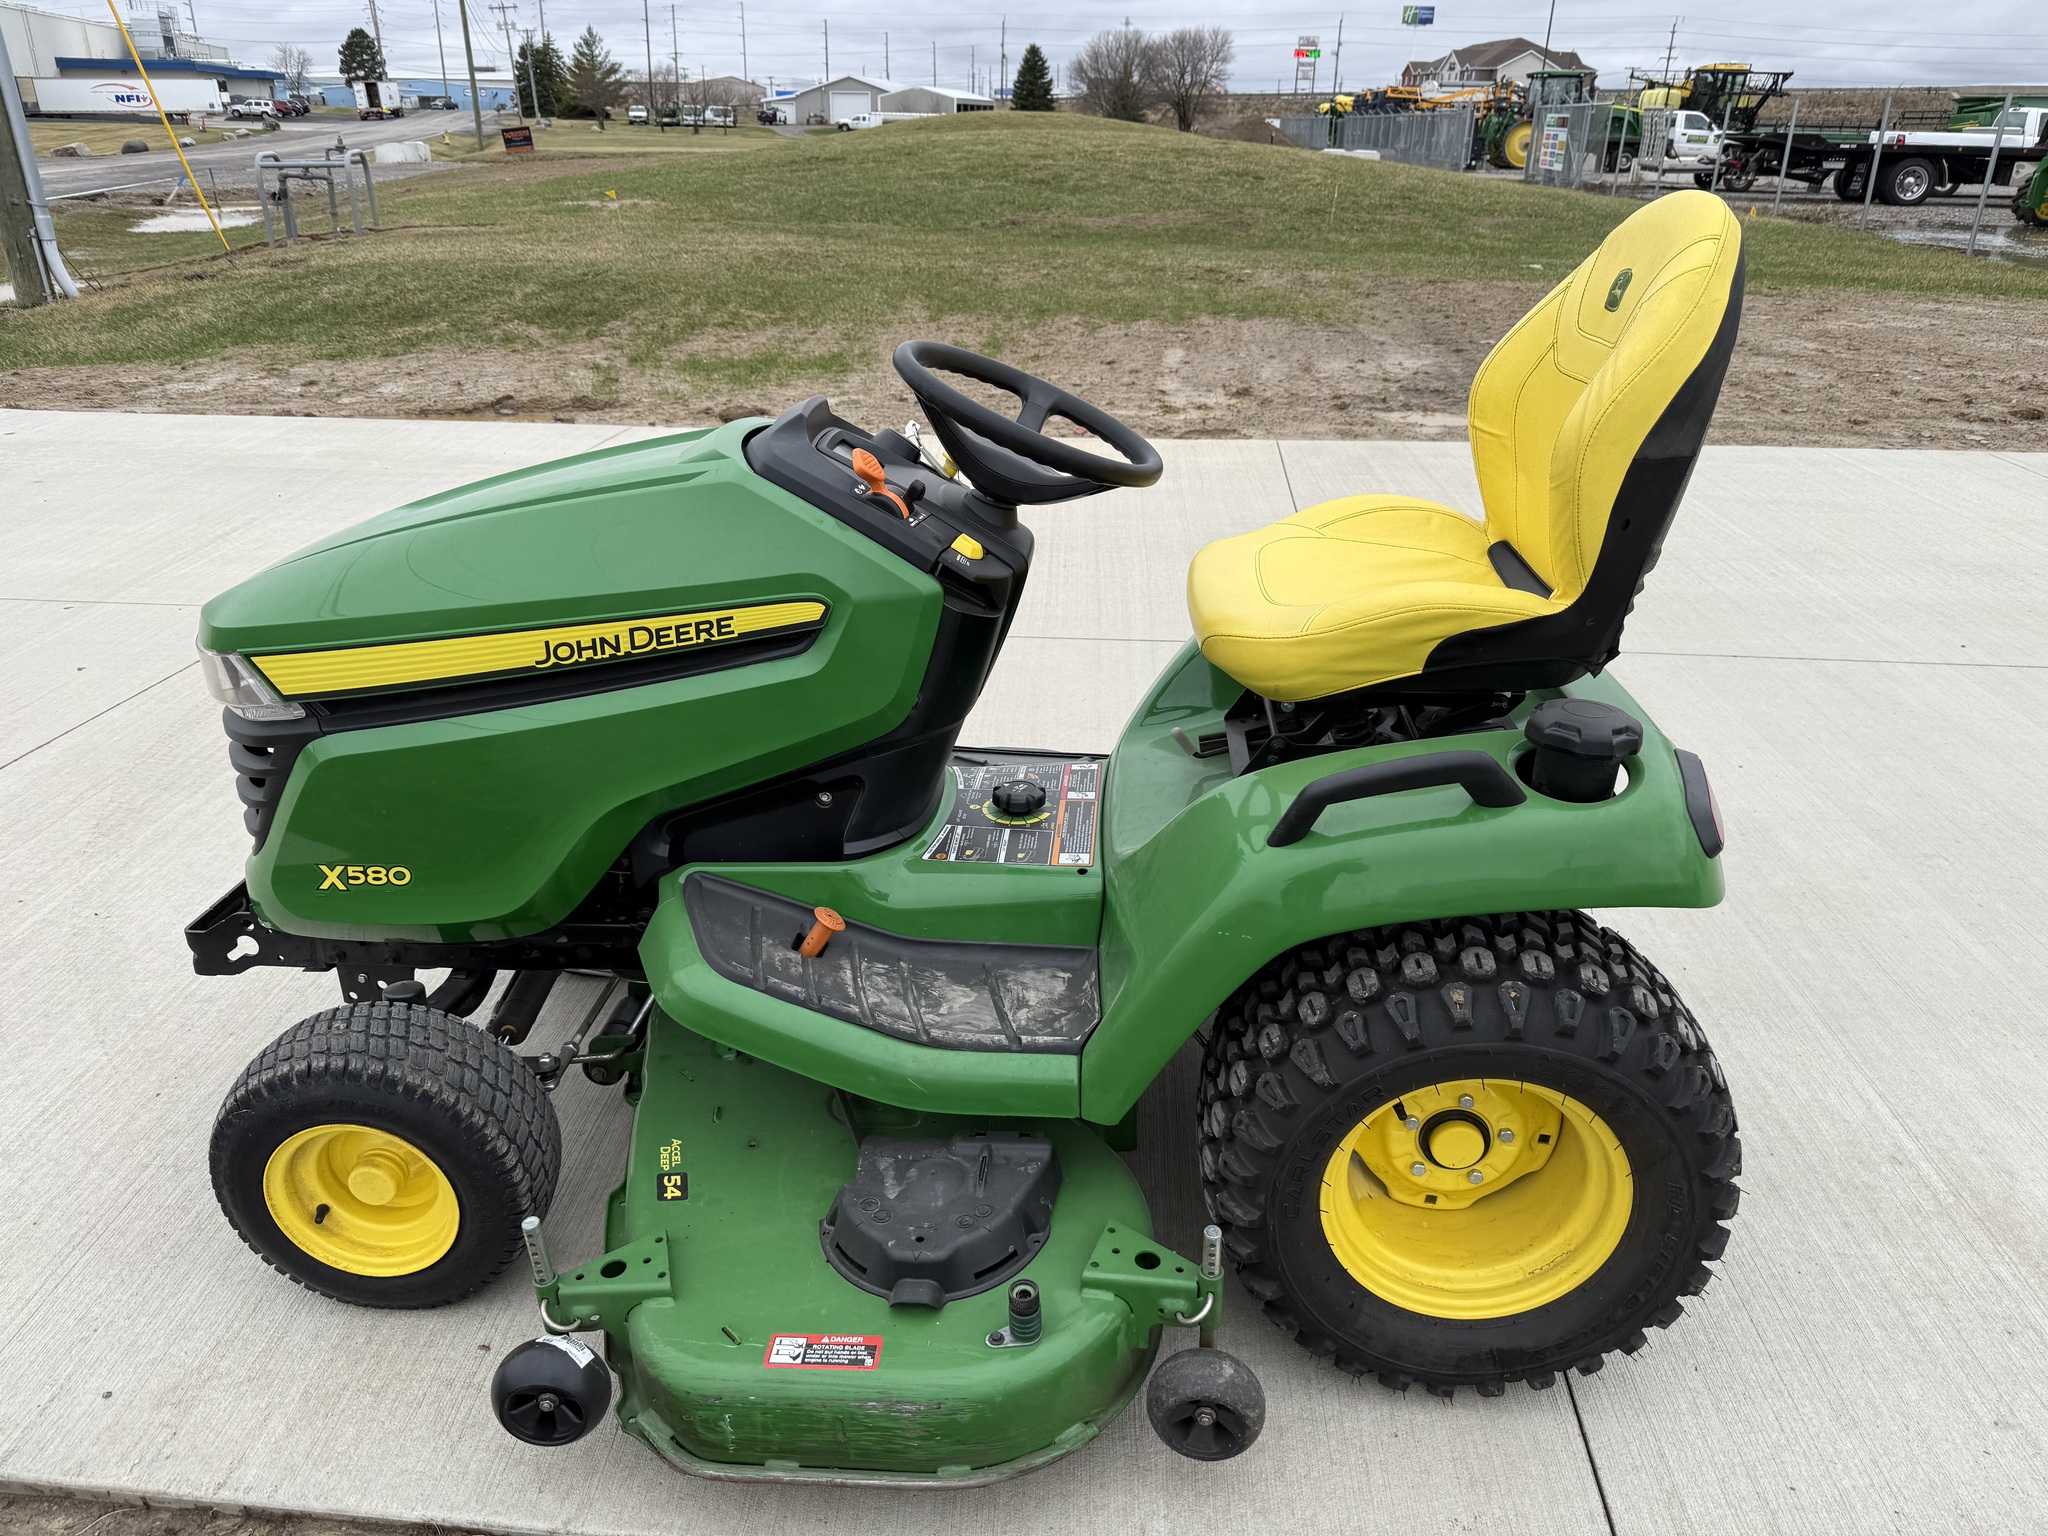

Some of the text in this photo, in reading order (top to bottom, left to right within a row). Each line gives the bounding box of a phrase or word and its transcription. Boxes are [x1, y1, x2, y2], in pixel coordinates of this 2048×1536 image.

[535, 616, 735, 666] JOHN DEERE
[316, 864, 413, 891] X580
[660, 1146, 670, 1171] DEEP
[671, 1138, 682, 1167] ACCEL
[1281, 1083, 1385, 1221] CARLSTAR
[663, 1175, 682, 1200] 54
